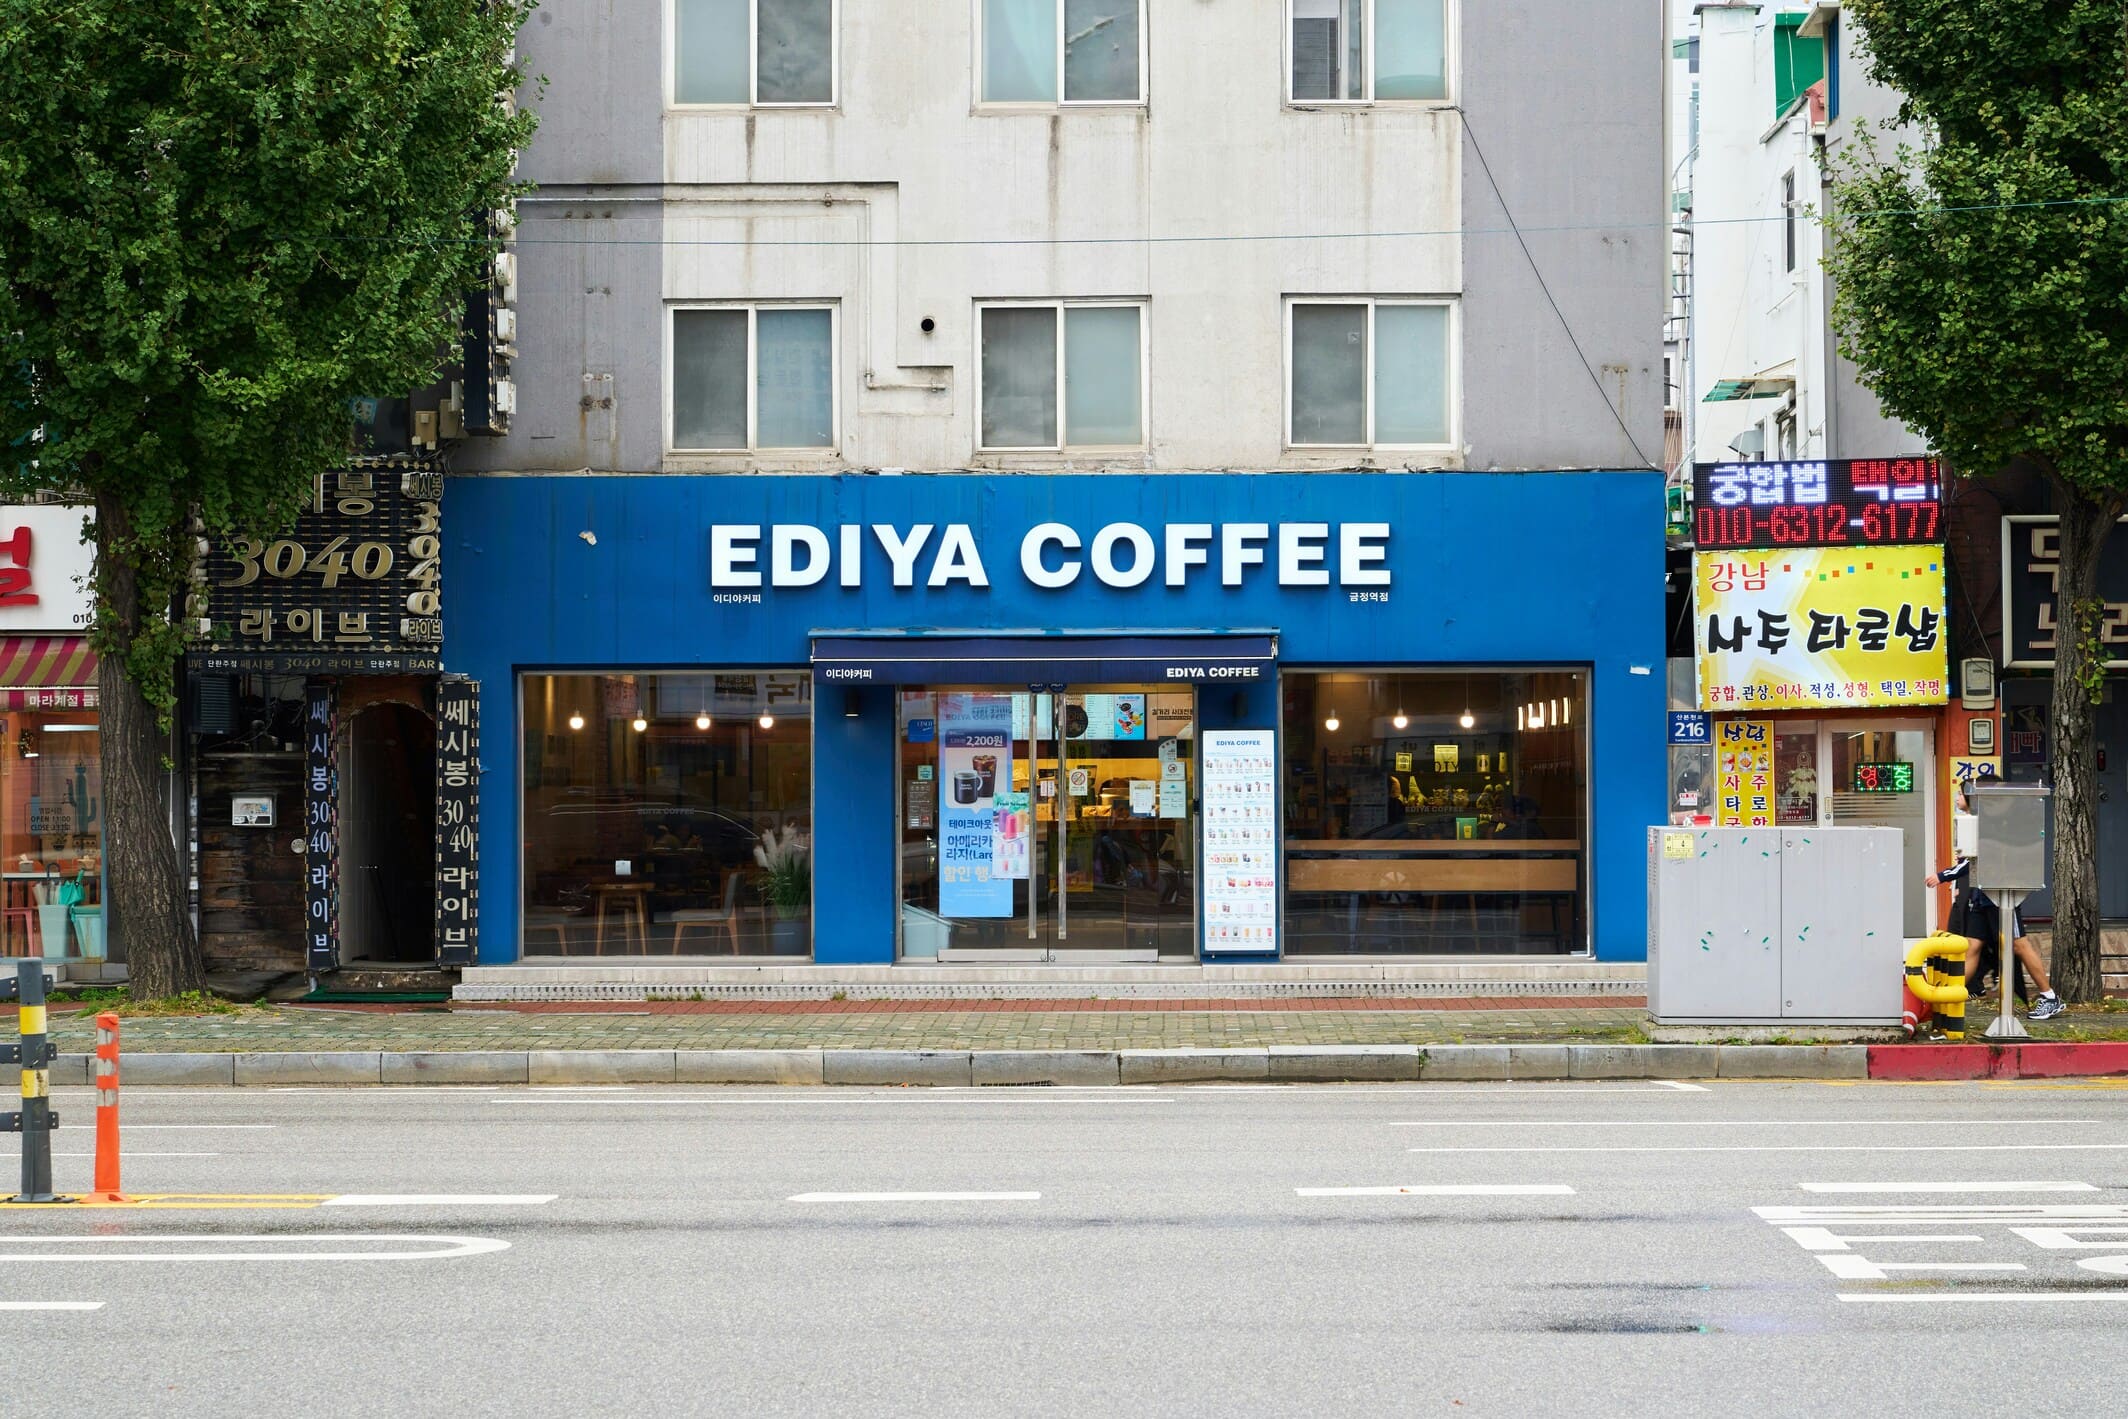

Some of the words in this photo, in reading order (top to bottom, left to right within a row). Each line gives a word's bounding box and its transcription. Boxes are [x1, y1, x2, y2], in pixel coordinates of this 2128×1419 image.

[1710, 463, 1826, 504] 궁합법
[1851, 460, 1938, 501] 택일
[1698, 501, 1938, 544] 010-6312-6177
[219, 536, 393, 588] 3040
[711, 524, 990, 586] EDIYA
[1020, 522, 1391, 588] COFFEE
[1708, 562, 1769, 592] 강남
[713, 593, 761, 604] 이디야커피
[1349, 592, 1389, 602] 금정역점
[239, 608, 373, 643] 라이브
[408, 619, 443, 641] 라이브
[1807, 603, 1939, 653] 타로샵
[284, 658, 320, 669] 3040
[327, 659, 364, 670] 라이브
[408, 659, 435, 669] BAR
[825, 669, 872, 679] 이디야커피
[1166, 667, 1205, 677] EDIYA
[1208, 667, 1259, 677] COFFEE
[29, 695, 78, 707] 마라계절
[1675, 722, 1705, 737] 216
[1724, 722, 1766, 741] 상담
[966, 735, 1003, 747] 2,200원
[949, 819, 992, 830] 테이크아웃
[947, 835, 993, 848] 아메리카
